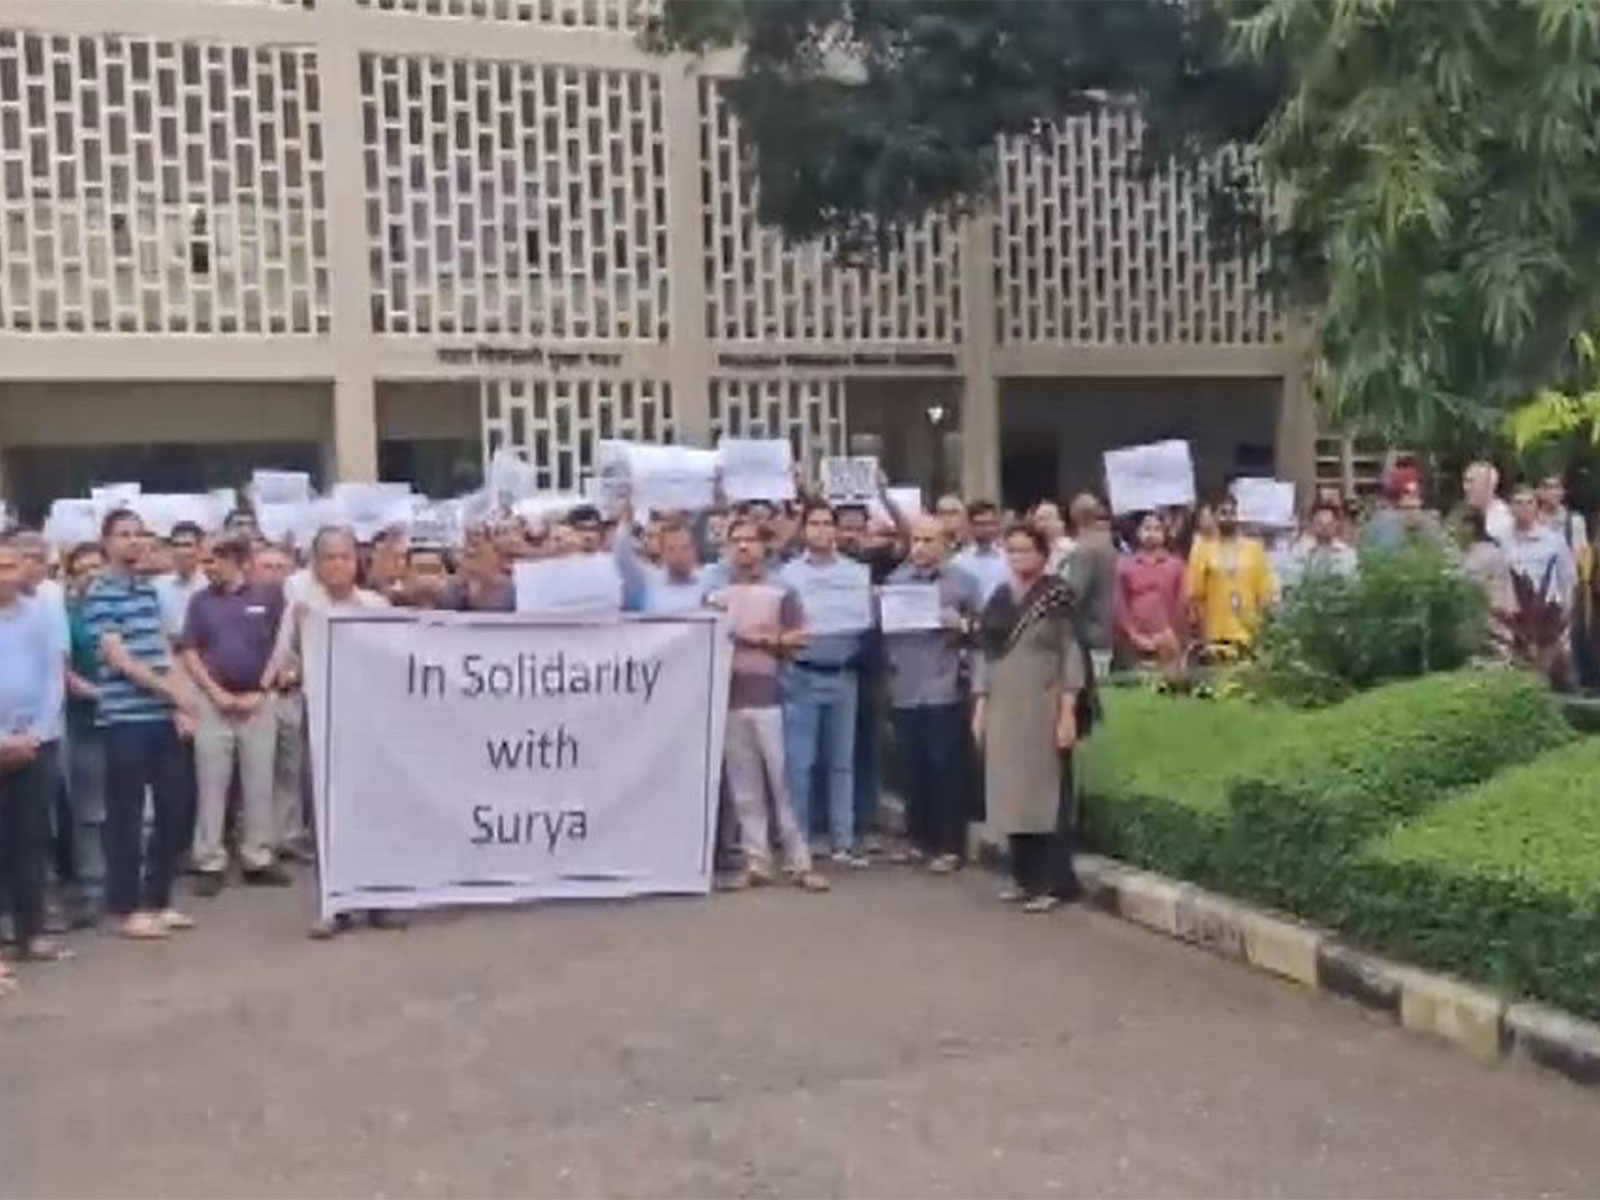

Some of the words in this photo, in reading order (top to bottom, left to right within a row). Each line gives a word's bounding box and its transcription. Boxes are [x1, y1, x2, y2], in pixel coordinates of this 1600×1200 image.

[406, 653, 446, 699] In
[461, 652, 662, 702] Solidarity
[486, 724, 580, 769] with
[469, 805, 589, 853] Surya
